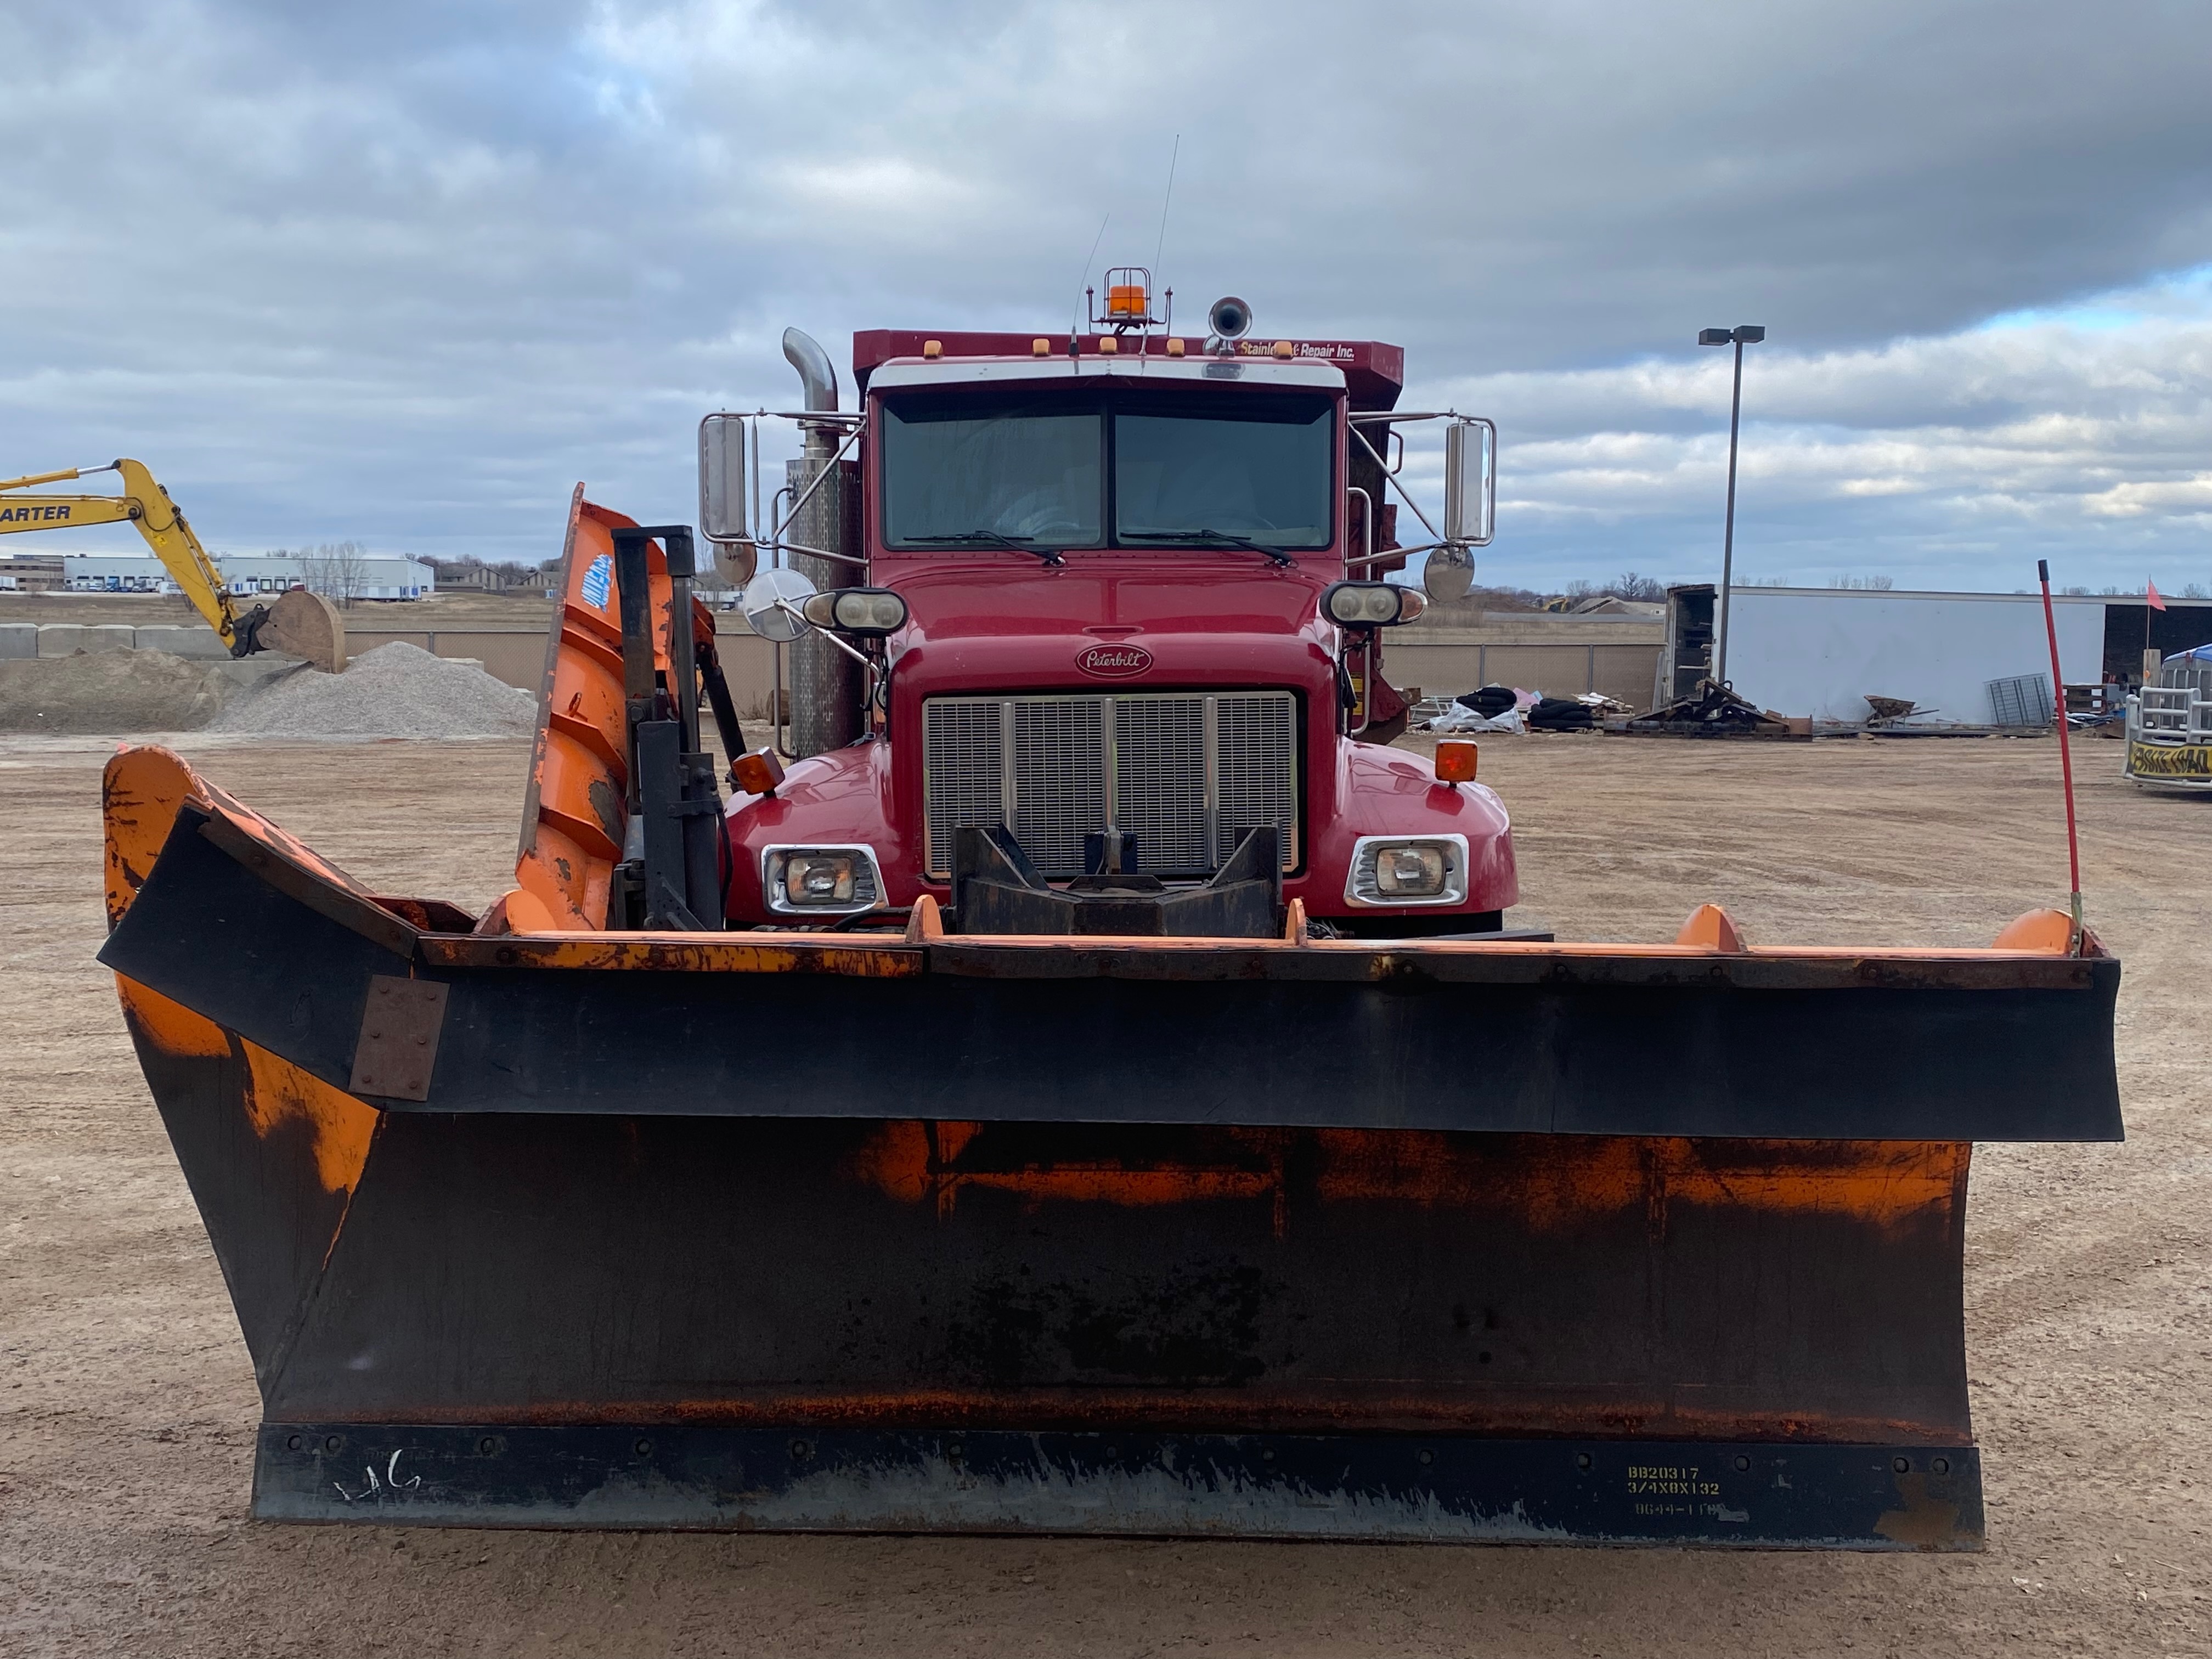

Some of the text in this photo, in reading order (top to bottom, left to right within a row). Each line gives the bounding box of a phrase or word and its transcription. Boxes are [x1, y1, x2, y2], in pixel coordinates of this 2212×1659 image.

[1301, 343, 1334, 358] Repair
[1336, 344, 1355, 358] Inc.
[1087, 650, 1145, 668] Peterbilt
[1628, 1466, 1699, 1480] BB20317
[1628, 1482, 1720, 1496] 3/4X8X132
